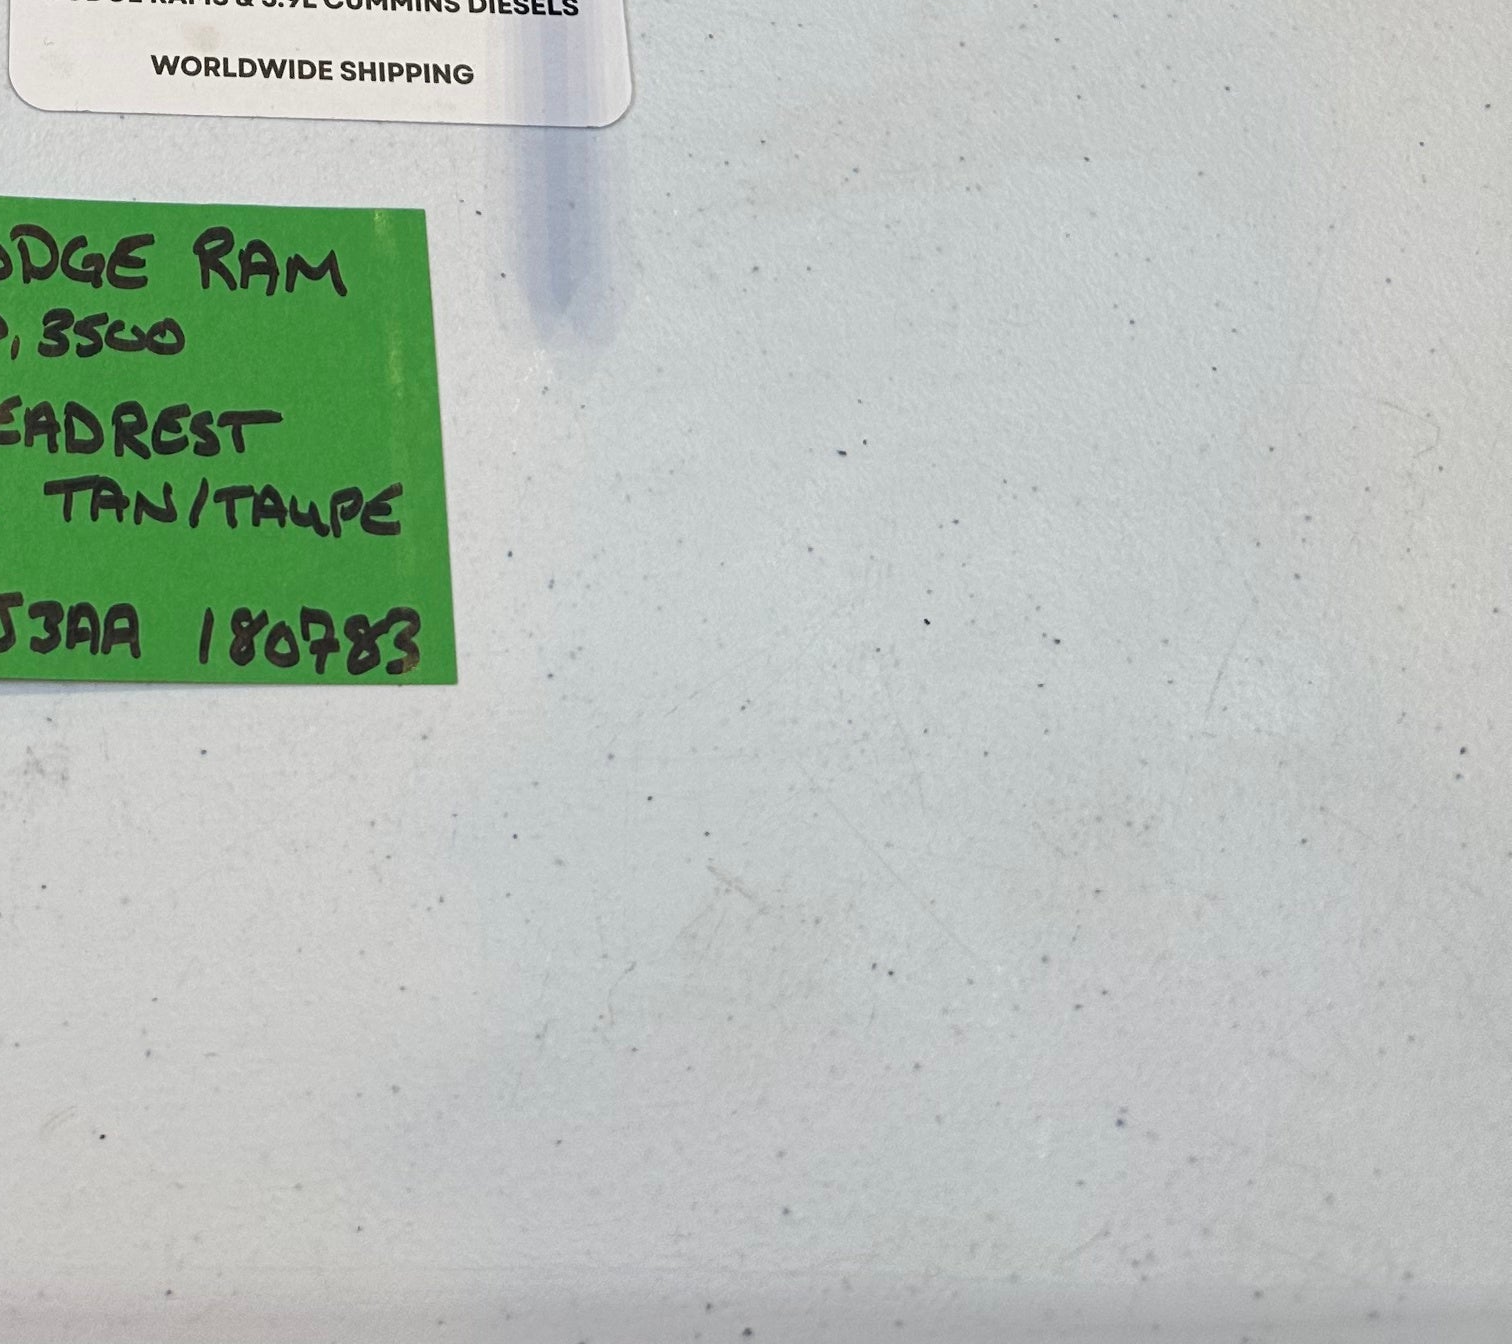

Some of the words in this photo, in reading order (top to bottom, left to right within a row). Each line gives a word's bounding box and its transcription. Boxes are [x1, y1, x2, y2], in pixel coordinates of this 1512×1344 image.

[151, 55, 333, 80] WORLDWIDE
[341, 61, 474, 84] SHIPPING
[193, 227, 347, 297] RAM
[199, 606, 421, 675] 180783
